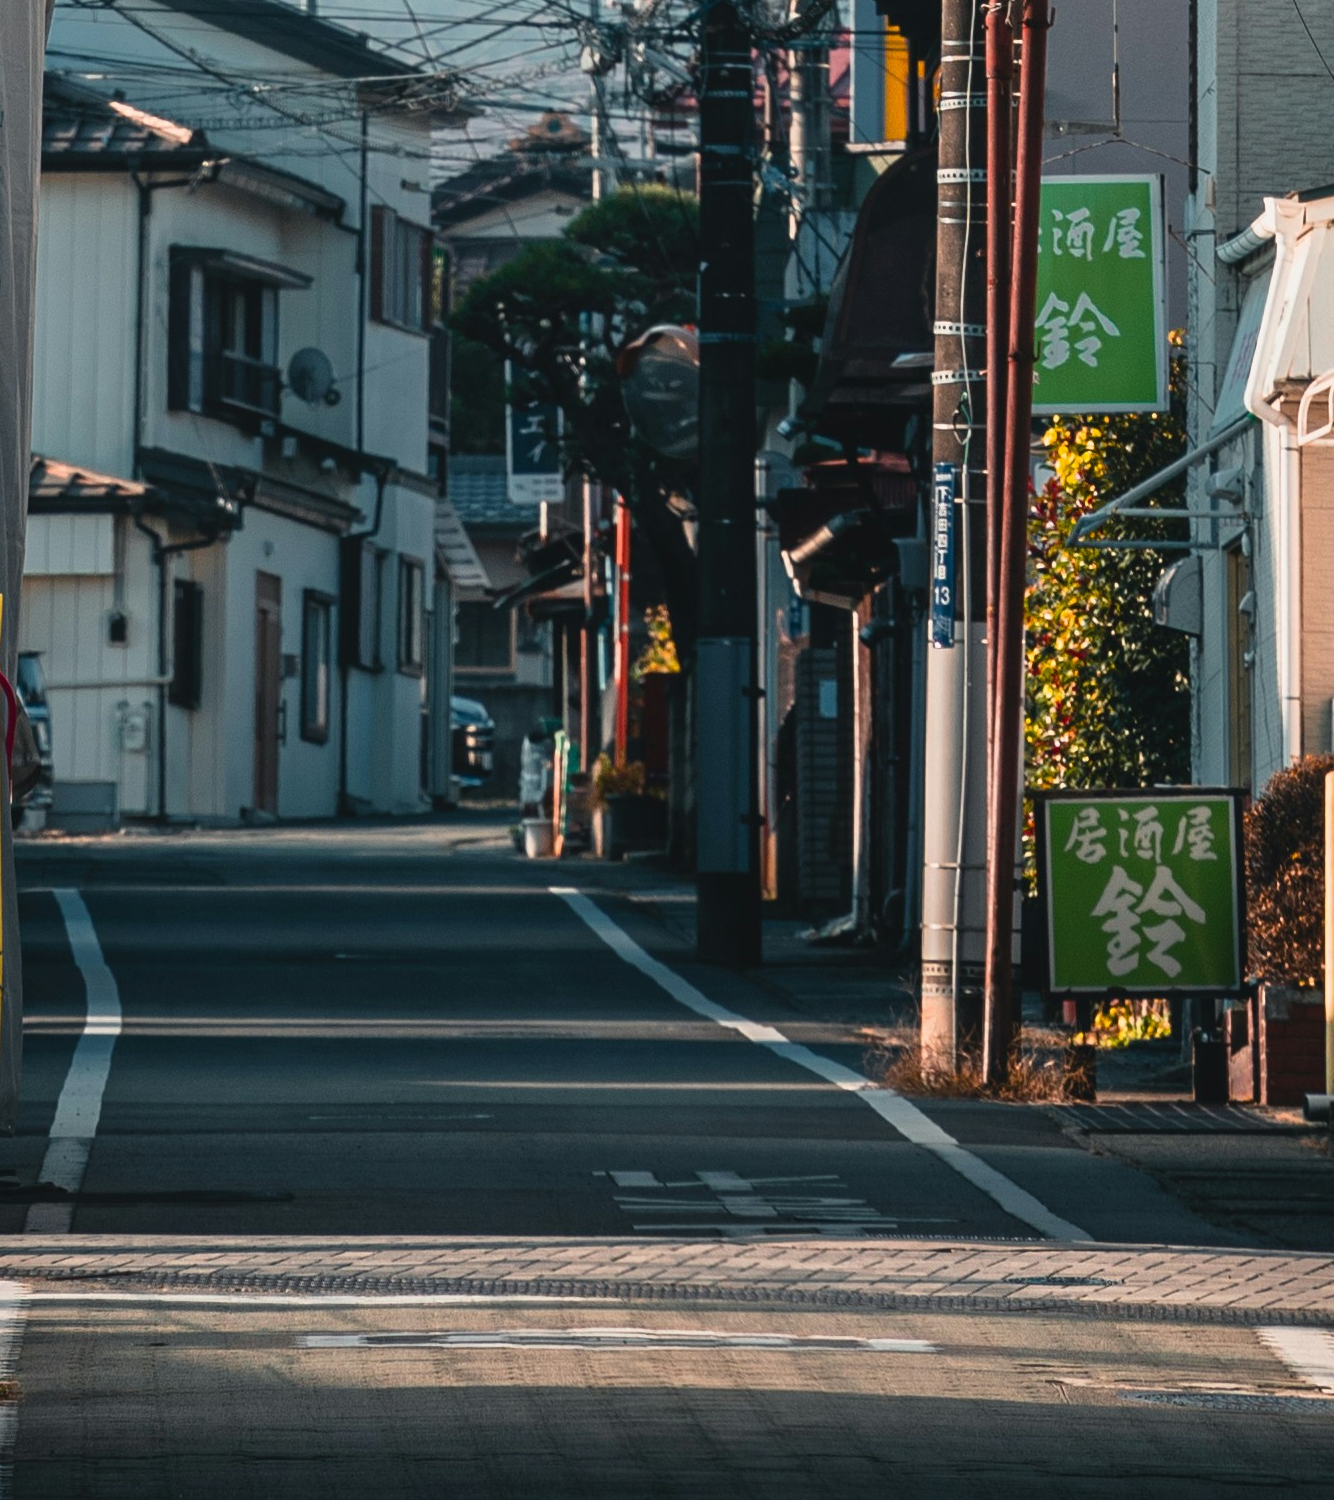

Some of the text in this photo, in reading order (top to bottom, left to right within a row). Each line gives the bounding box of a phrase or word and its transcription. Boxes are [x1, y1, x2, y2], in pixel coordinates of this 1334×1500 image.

[1037, 206, 1146, 262] 酒屋
[1035, 291, 1121, 371] 鈴
[933, 585, 951, 605] 13
[1064, 805, 1219, 864] 居酒屋
[1090, 865, 1206, 978] 鈴
